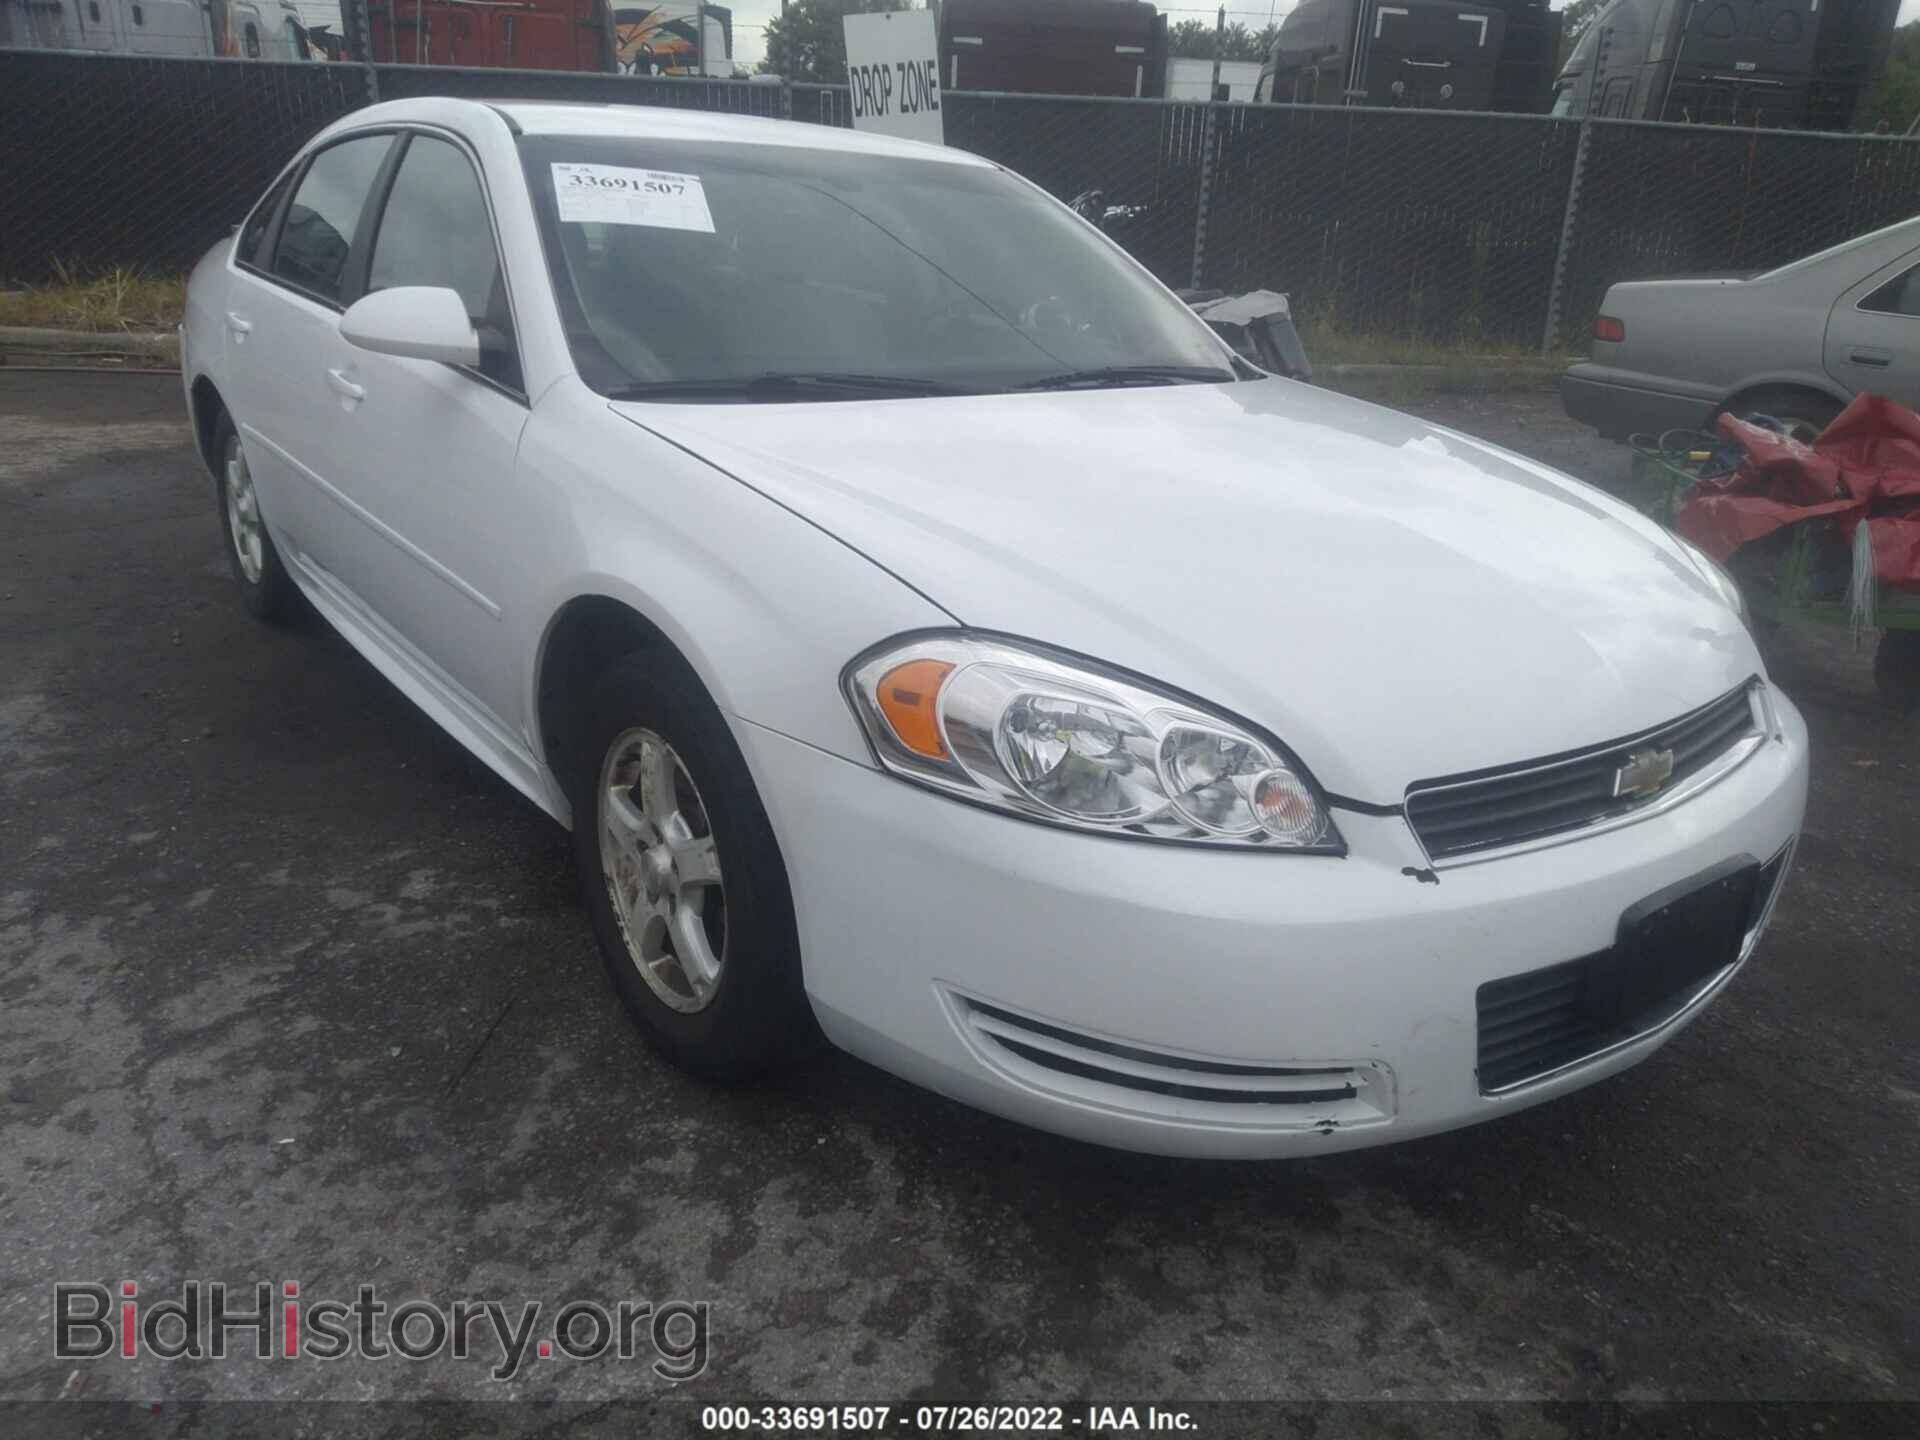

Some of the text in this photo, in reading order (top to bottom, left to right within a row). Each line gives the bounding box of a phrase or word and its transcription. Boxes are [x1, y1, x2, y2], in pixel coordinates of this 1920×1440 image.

[850, 60, 939, 117] DROP ZONE
[569, 175, 686, 195] 33691507
